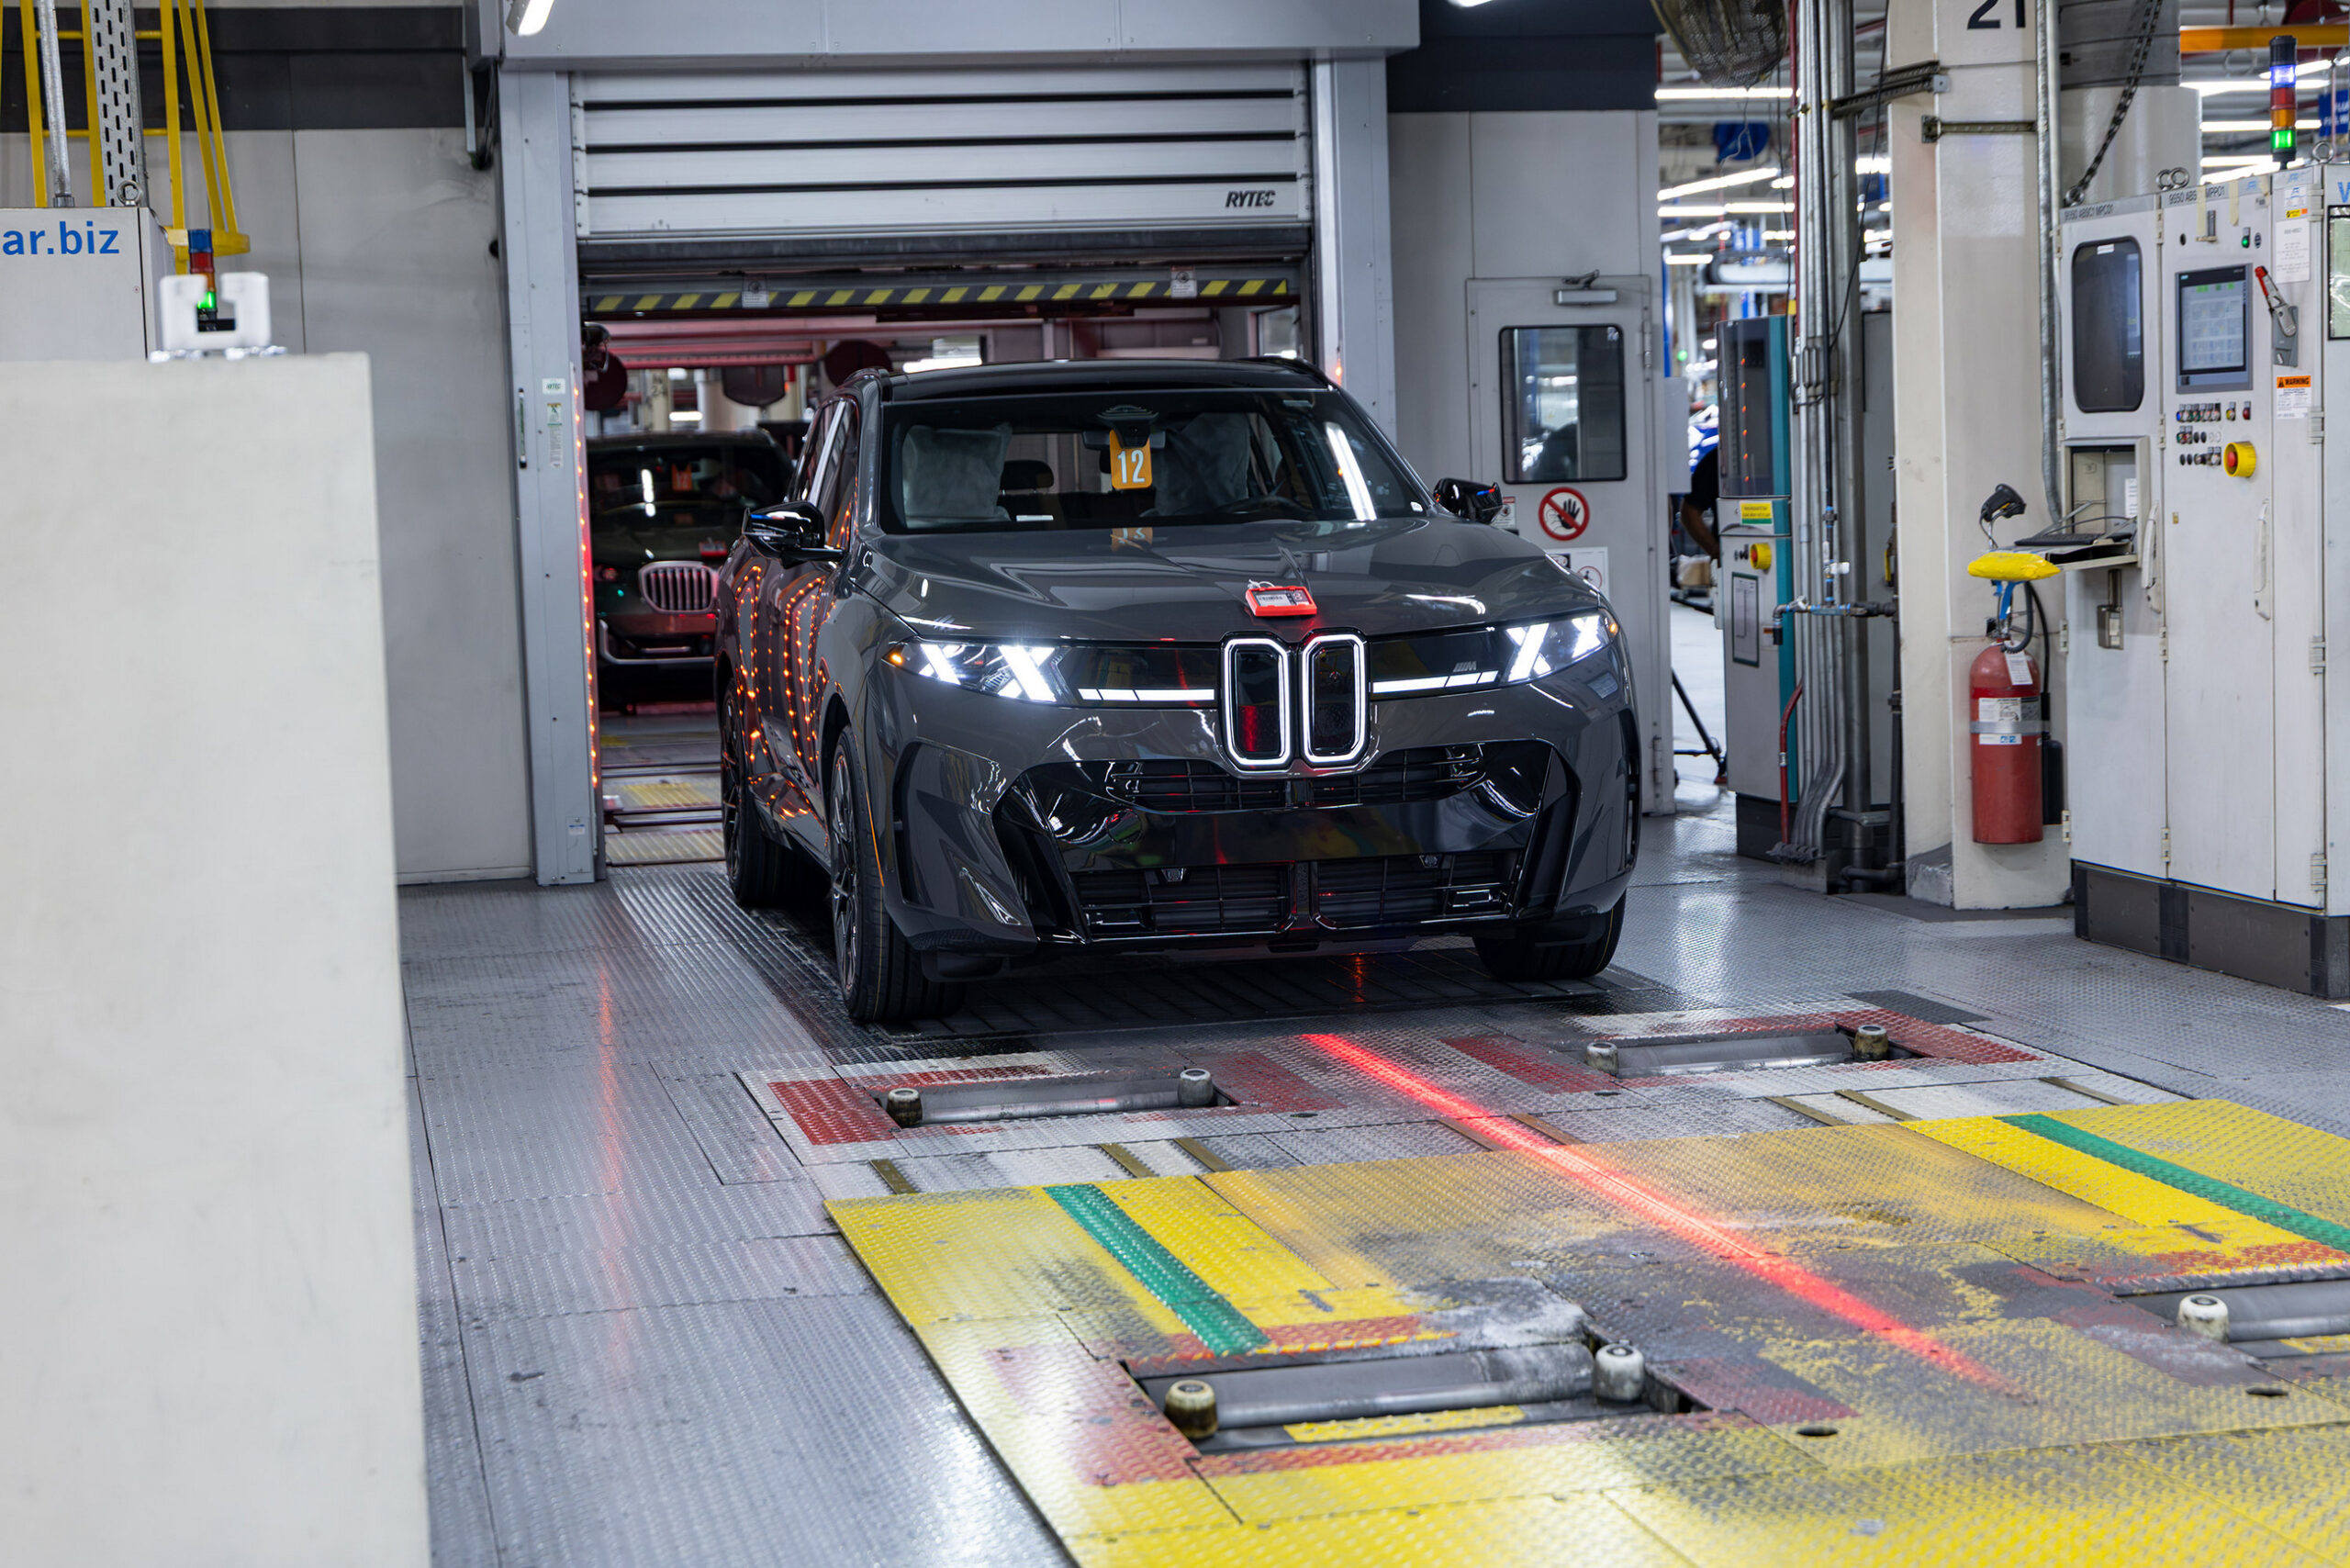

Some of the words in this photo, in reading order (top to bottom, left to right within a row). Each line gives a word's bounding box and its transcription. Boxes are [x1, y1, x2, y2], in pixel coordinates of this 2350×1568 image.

[1967, 0, 2026, 29] 21
[1225, 190, 1275, 207] RYTEC
[2, 221, 119, 255] ar.biz
[1118, 449, 1145, 484] 12
